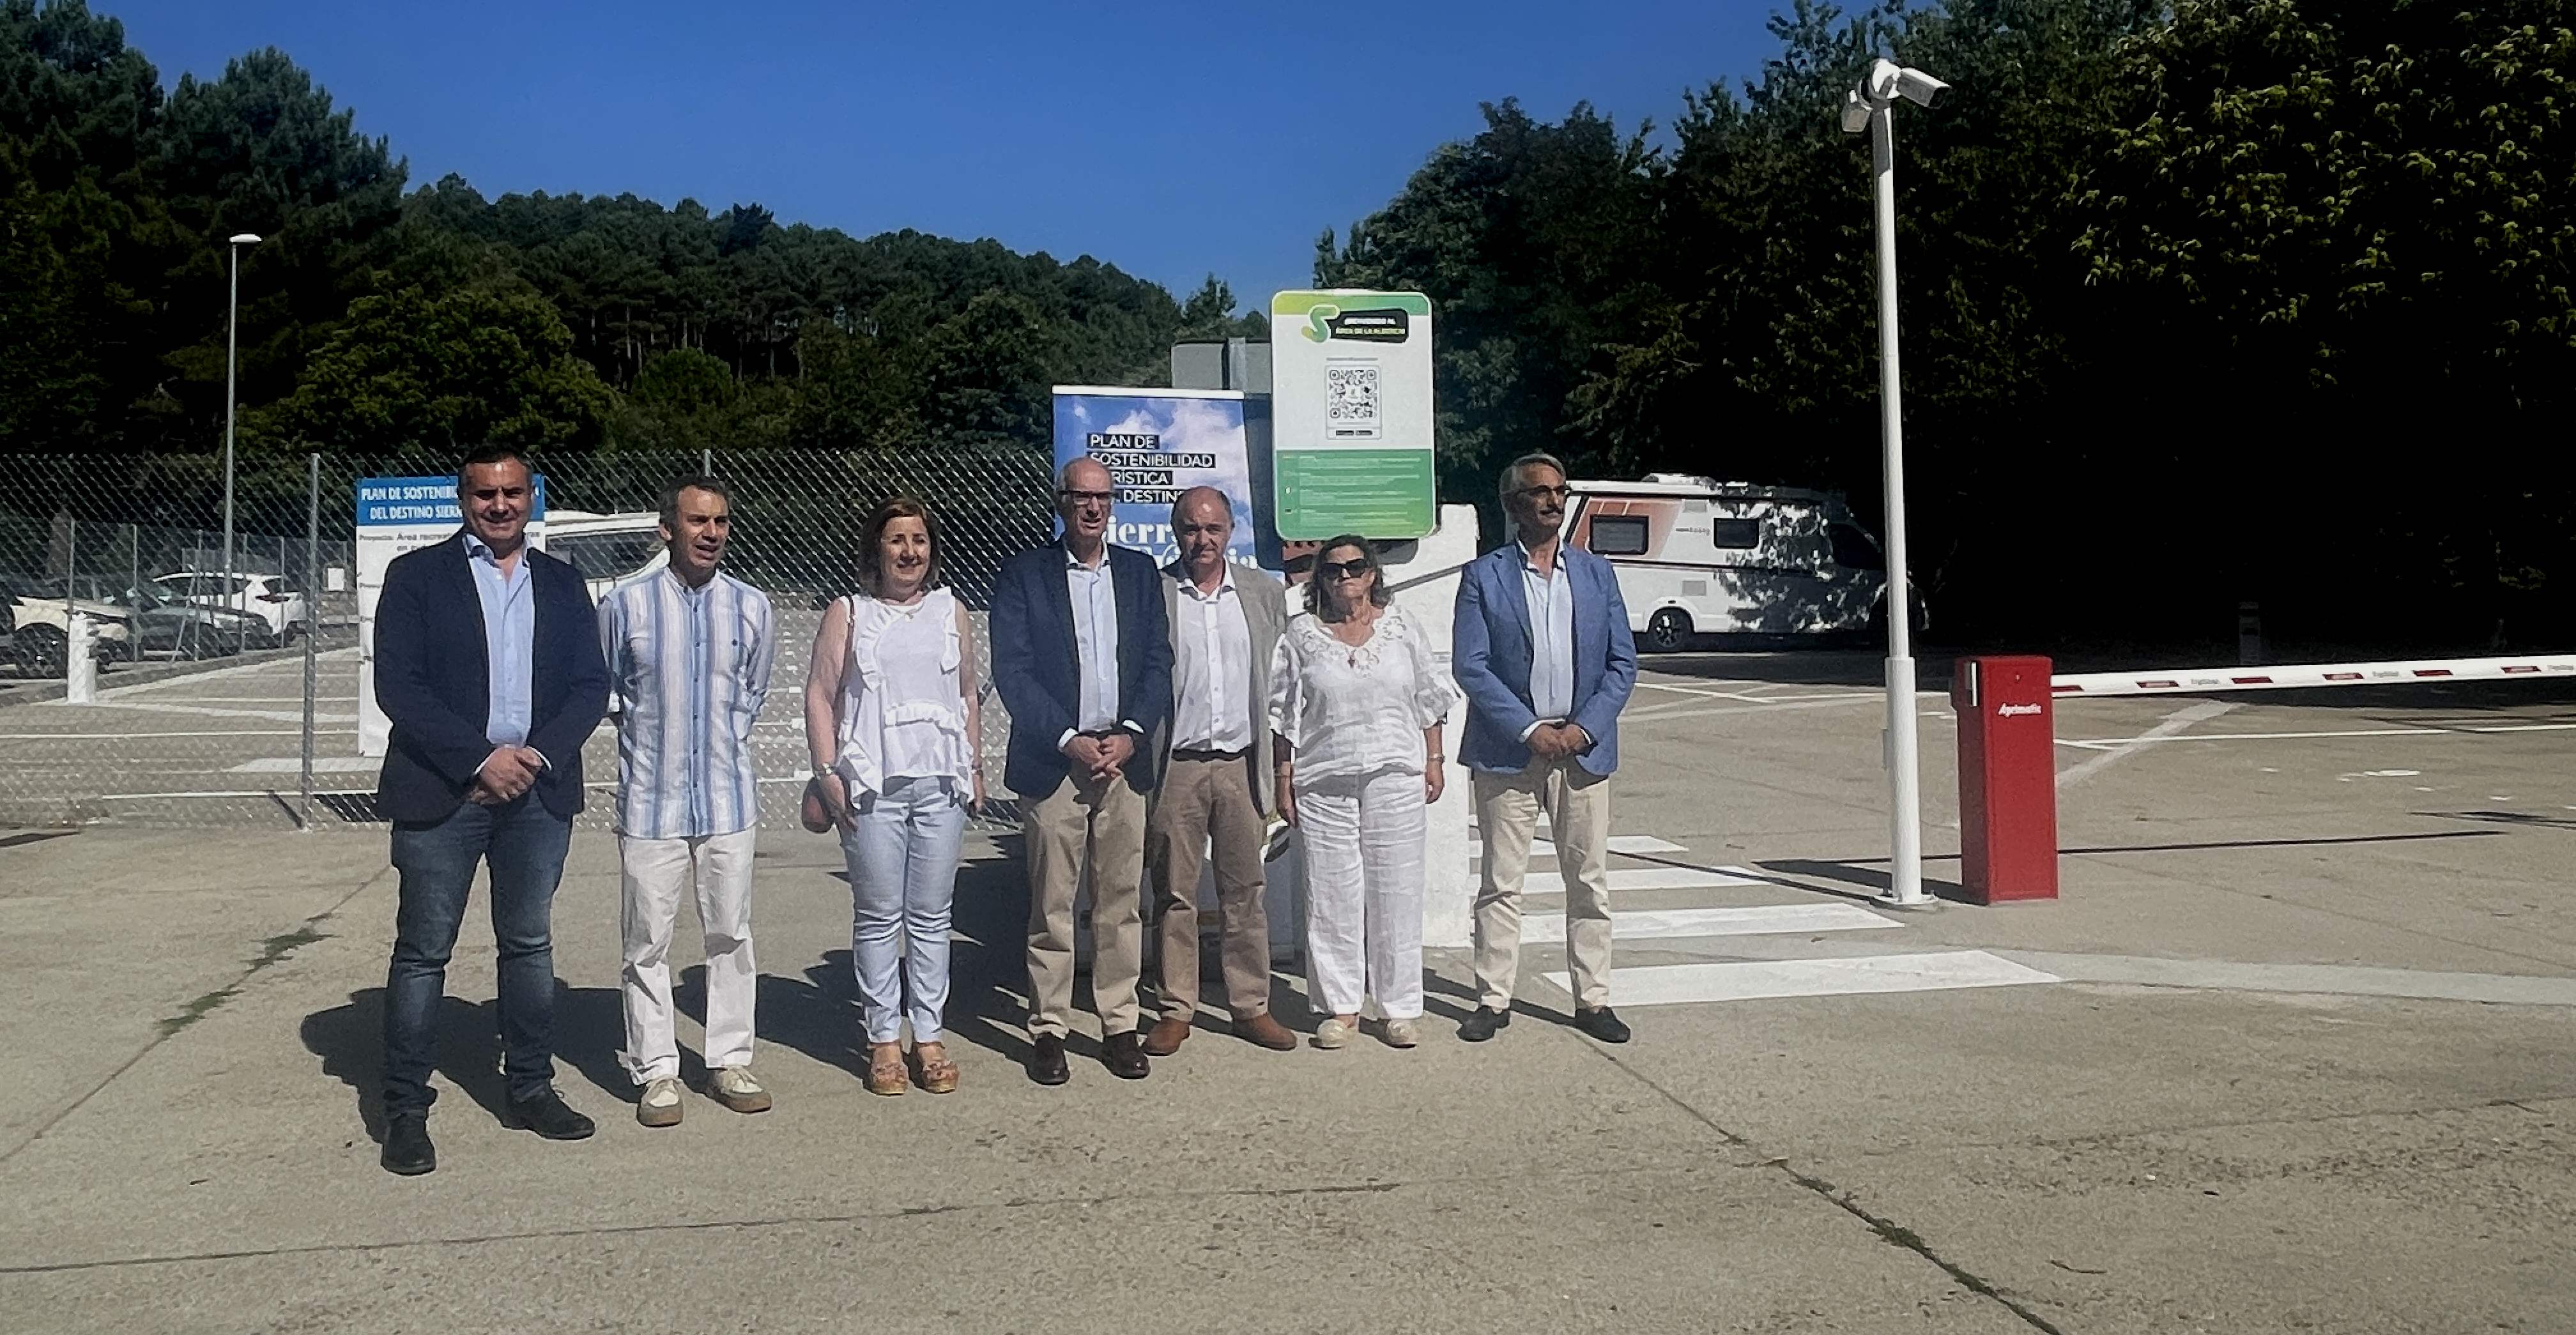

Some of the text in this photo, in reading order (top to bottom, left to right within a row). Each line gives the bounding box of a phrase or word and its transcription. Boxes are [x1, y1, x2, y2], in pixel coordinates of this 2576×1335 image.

[1090, 434, 1155, 448] PLAN DE
[1090, 452, 1213, 468] SOSTENIBILIDAD
[1112, 469, 1169, 484] RÍSTICA
[362, 487, 387, 501] PLAN
[388, 486, 402, 500] DE
[1123, 489, 1184, 503] DESTIN
[370, 507, 388, 520] DEL
[389, 505, 433, 519] DESTINO
[1103, 515, 1177, 544] ierr
